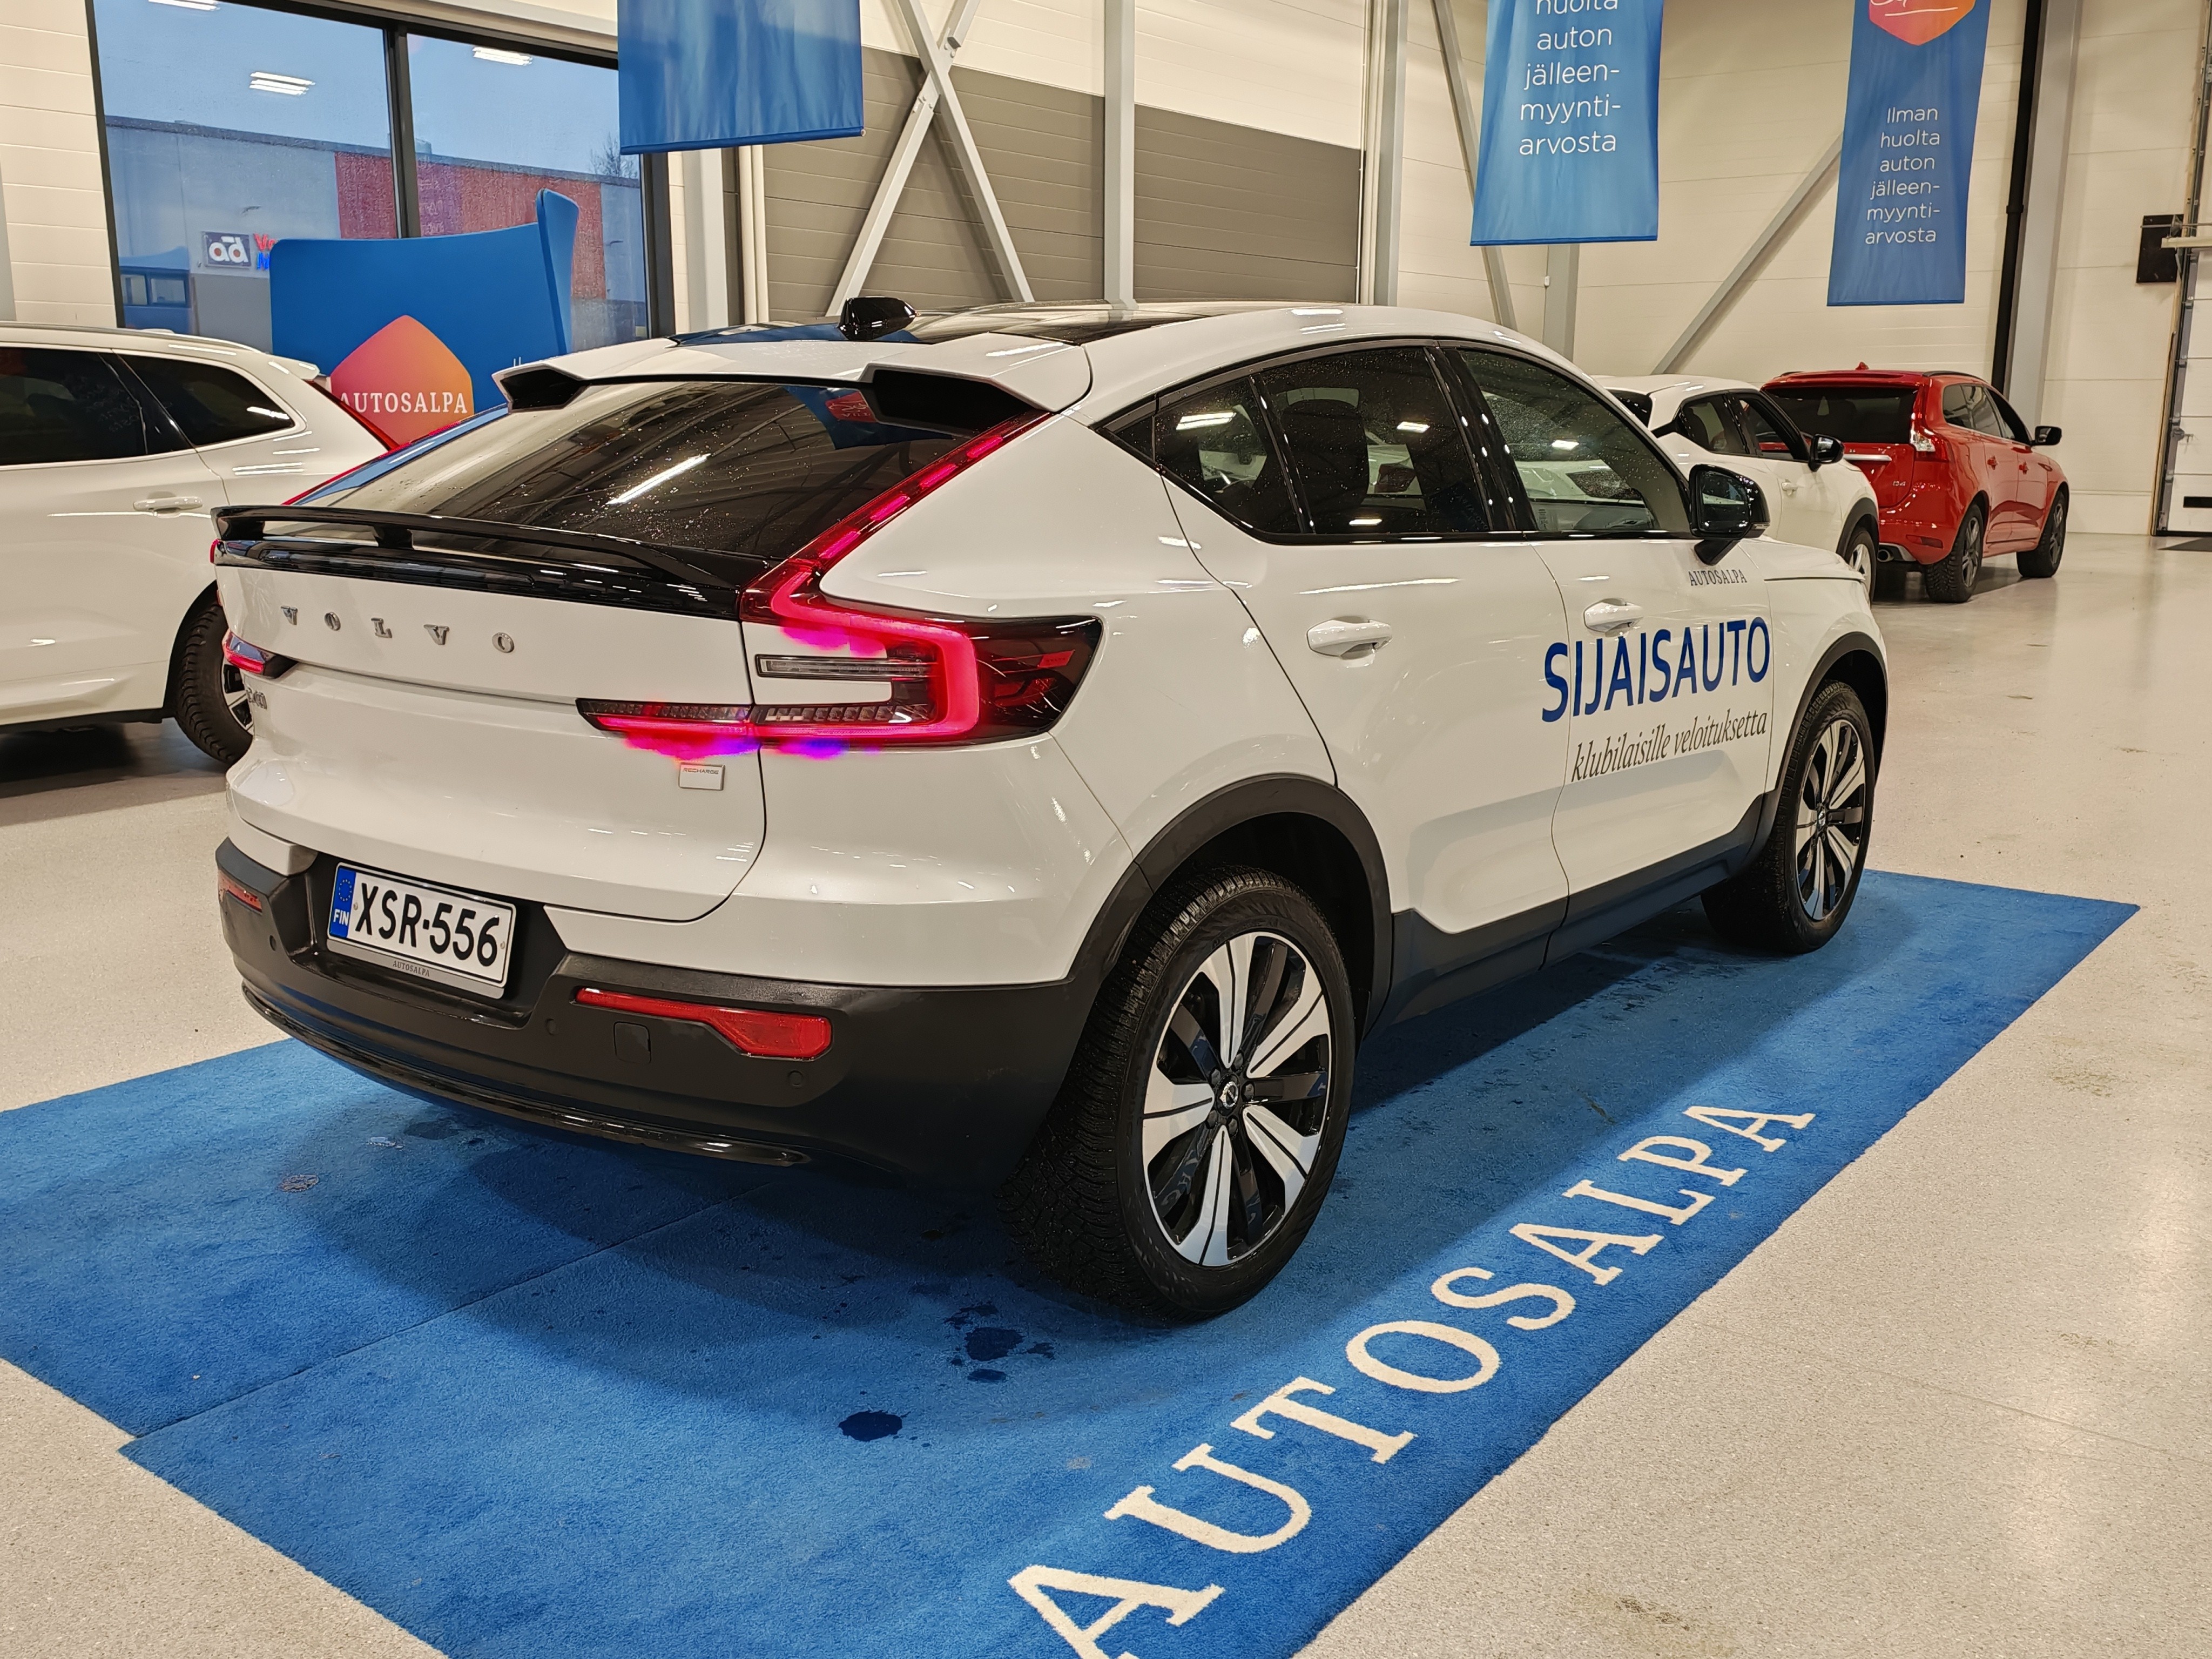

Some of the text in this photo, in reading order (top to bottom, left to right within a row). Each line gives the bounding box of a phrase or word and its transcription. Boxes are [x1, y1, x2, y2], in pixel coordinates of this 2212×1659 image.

[1537, 26, 1612, 50] auton
[1523, 61, 1620, 91] jälleen-
[1520, 93, 1621, 125] myynti-
[1887, 106, 1938, 124] Ilman
[1519, 130, 1616, 156] arvosta
[1880, 129, 1940, 149] huolta
[1879, 156, 1936, 172] auton
[1870, 179, 1940, 200] jälleen-
[1866, 201, 1941, 223] myynti-
[1865, 227, 1937, 245] arvosta
[1688, 569, 1748, 586] AUTOSALPA
[280, 605, 515, 653] VOLVO
[1541, 617, 1770, 723] SIJAISAUTO
[1571, 708, 1768, 783] klubilaisille veloituksetta
[333, 908, 349, 926] FIN
[392, 960, 430, 977] AUTOSALPA
[1007, 1105, 1816, 1659] AUTOSALPA
